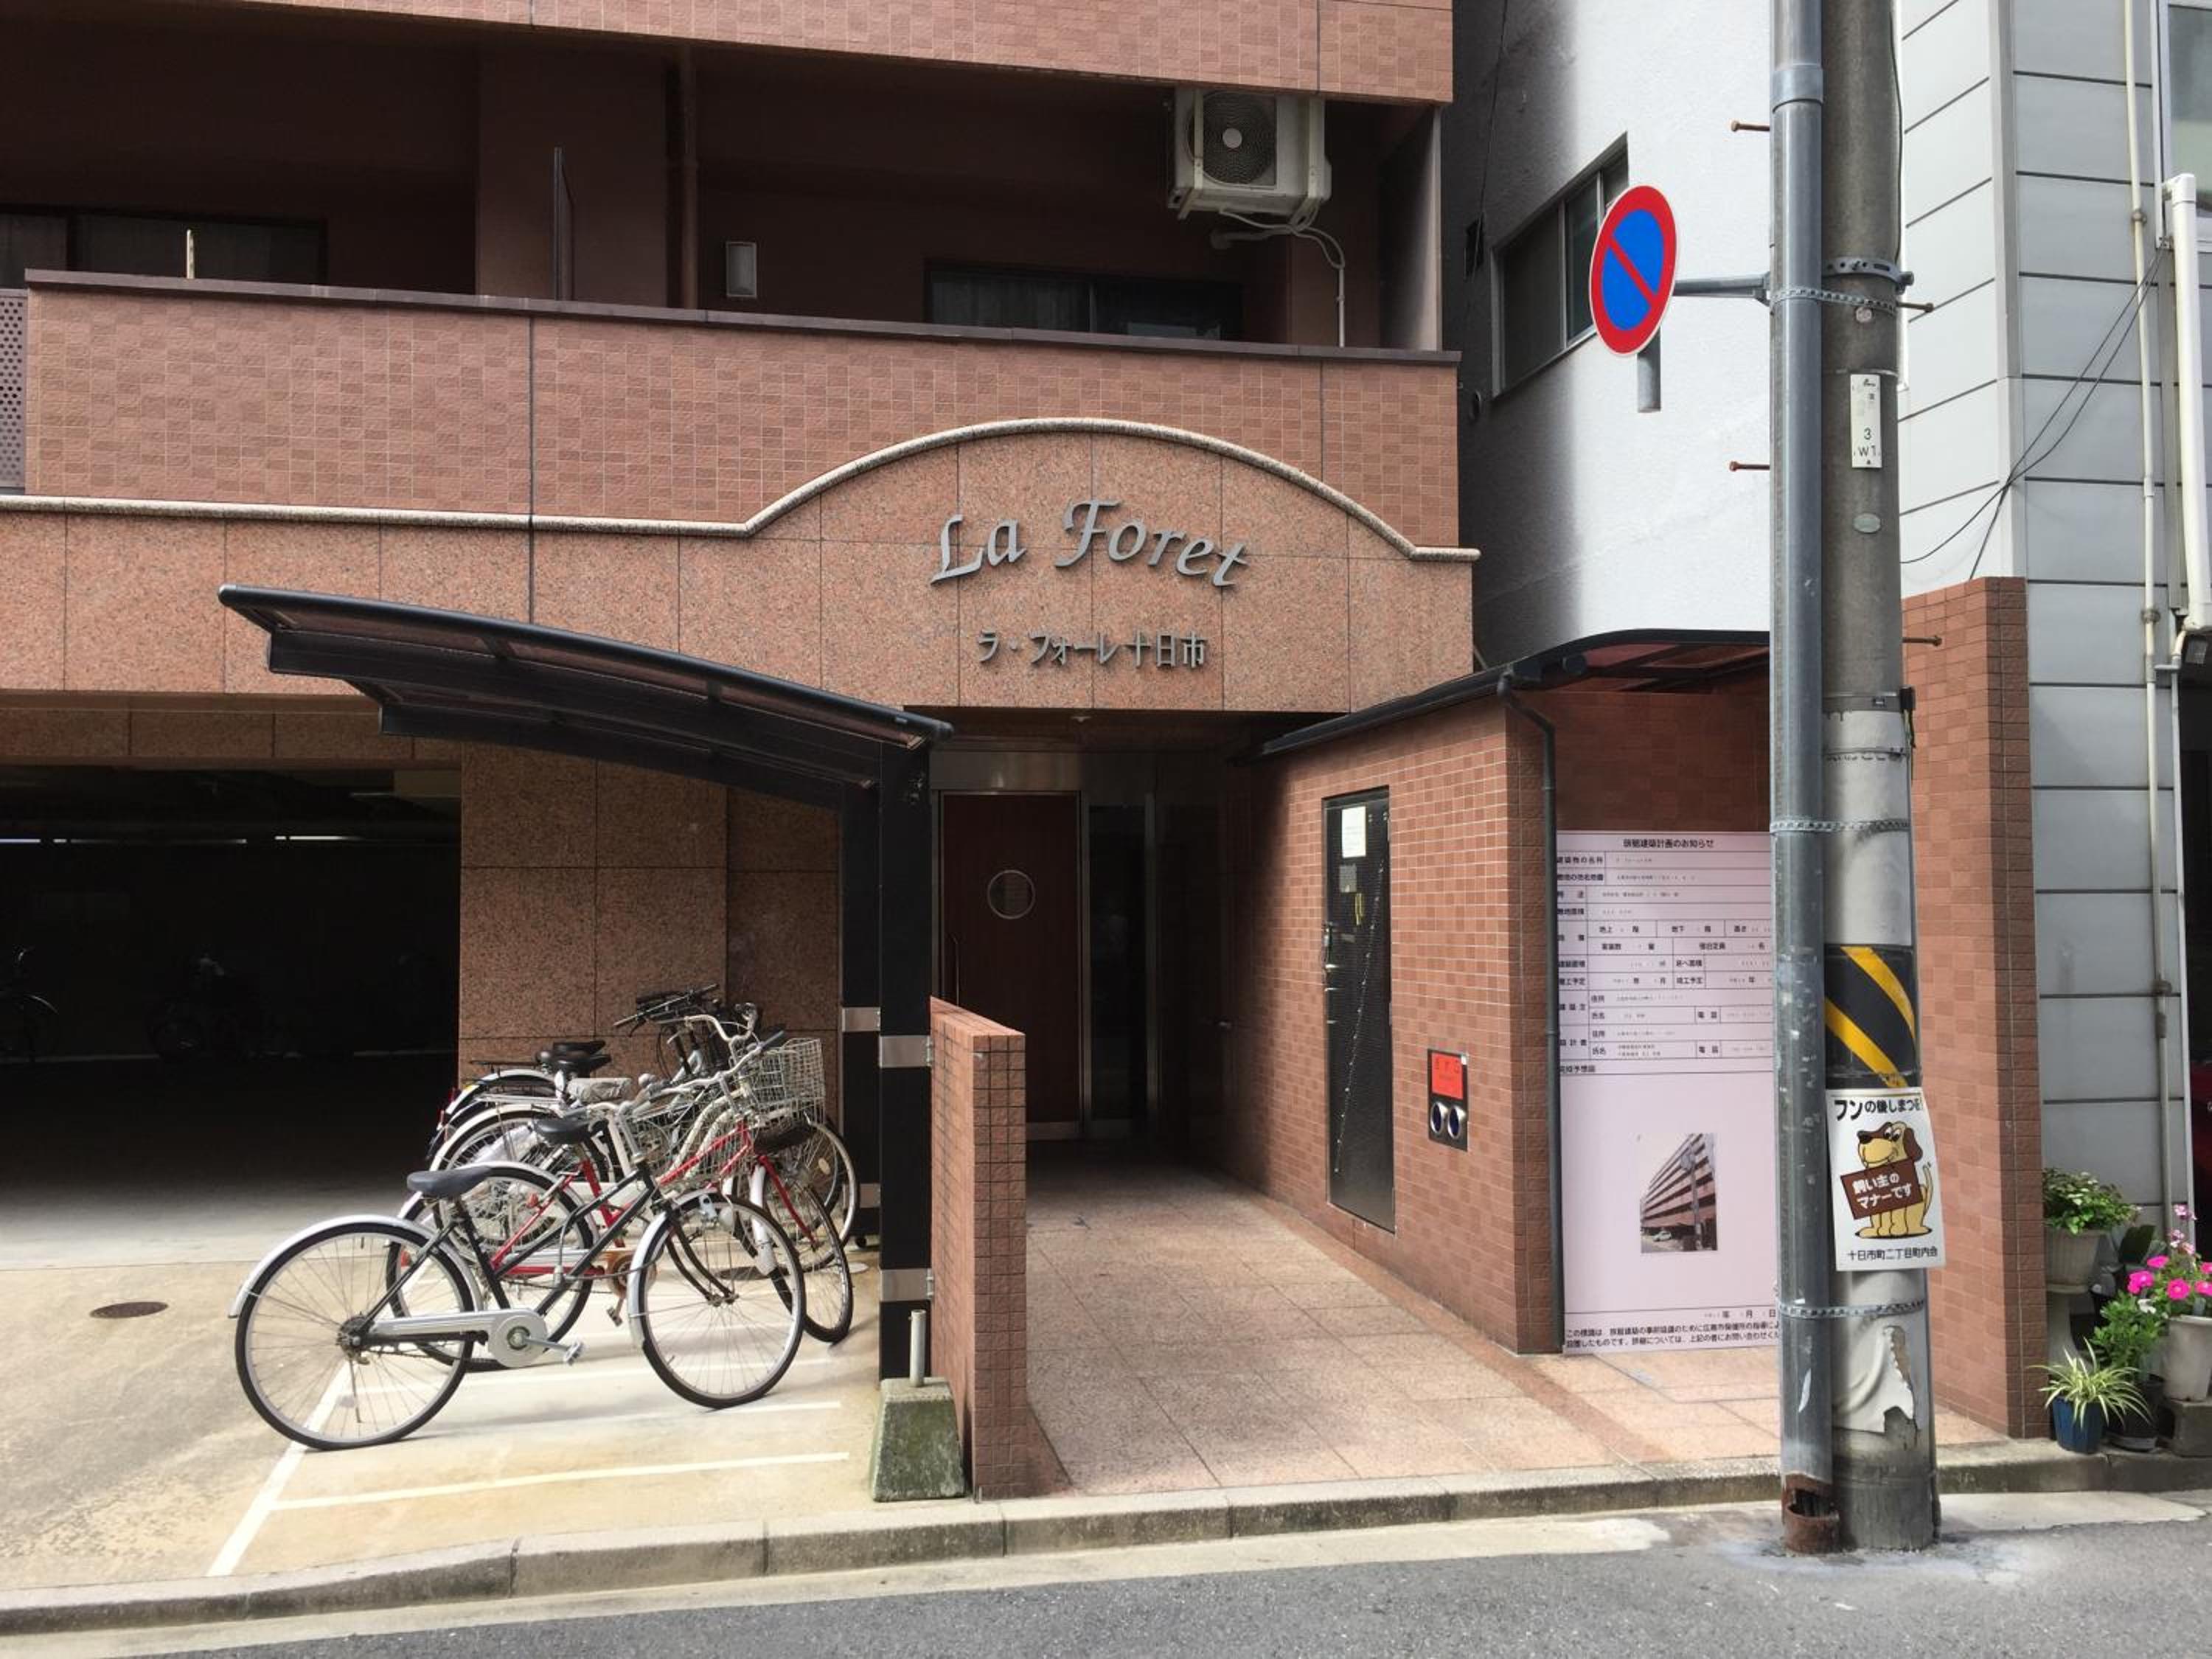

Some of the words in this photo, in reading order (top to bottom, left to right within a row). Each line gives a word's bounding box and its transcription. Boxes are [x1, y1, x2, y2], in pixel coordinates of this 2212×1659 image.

[1863, 427, 1872, 440] 3
[1857, 445, 1877, 456] W1
[930, 513, 1027, 585] La
[1054, 498, 1250, 588] Foret
[977, 630, 1208, 669] ラ・フォーレ十日市
[1852, 1172, 1900, 1194] 飼い主の
[1857, 1183, 1913, 1209] マナーです
[1848, 1245, 1938, 1262] 十日市町二丁目町内会
